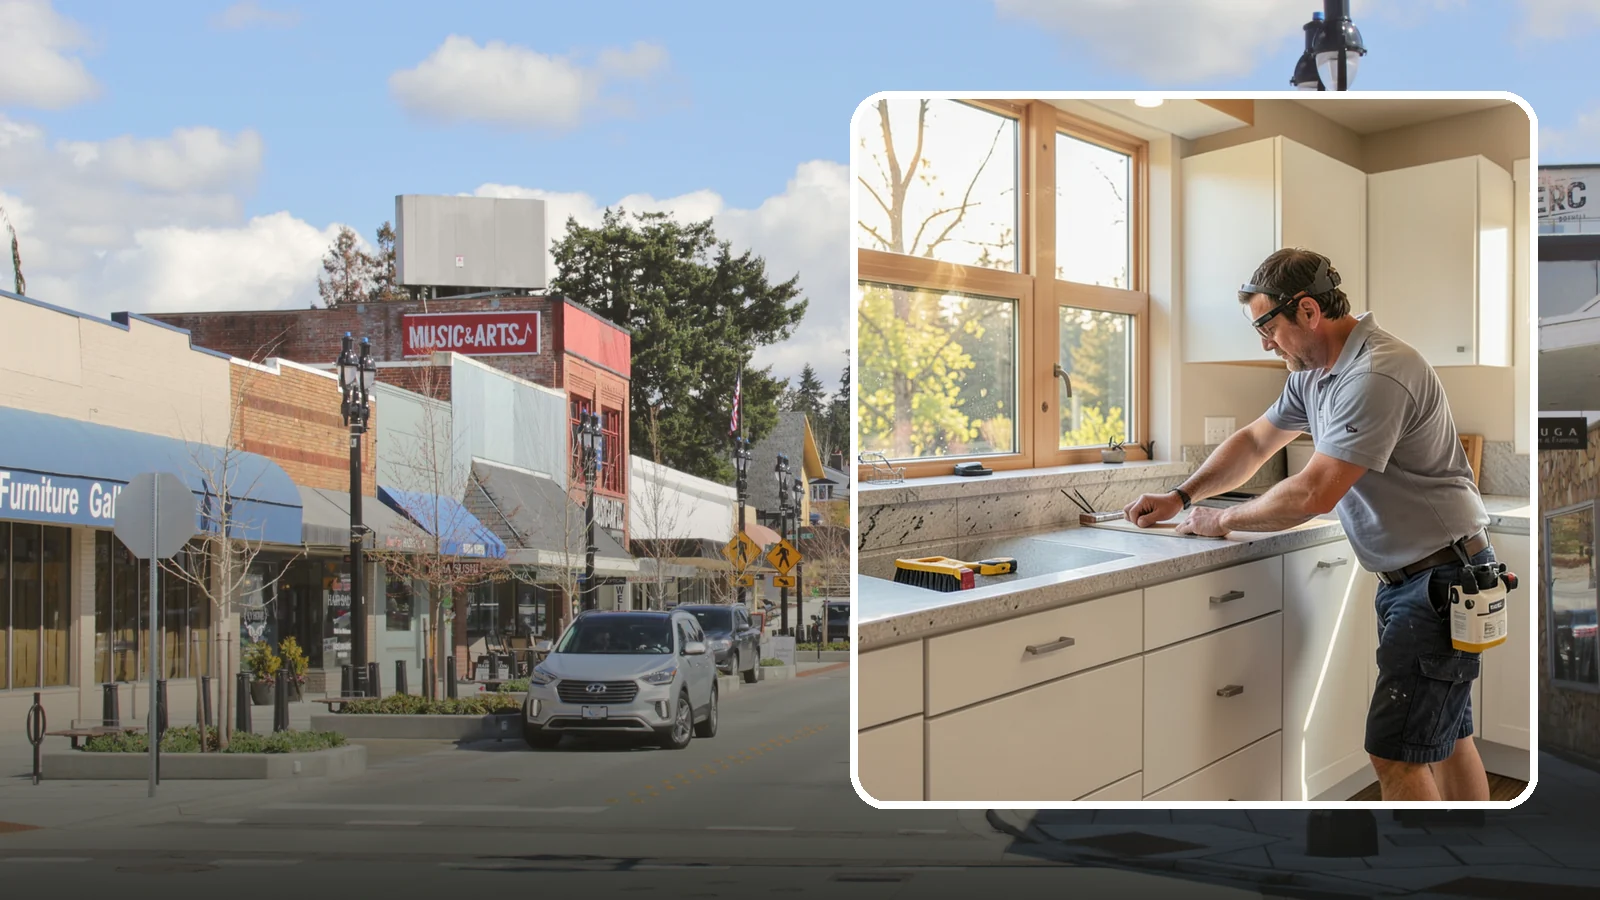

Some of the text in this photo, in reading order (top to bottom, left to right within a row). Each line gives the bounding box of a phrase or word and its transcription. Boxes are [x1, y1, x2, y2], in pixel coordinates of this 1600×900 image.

[1540, 428, 1577, 437] UGA
[0, 472, 79, 515] Furniture
[453, 563, 480, 574] SUSHI
